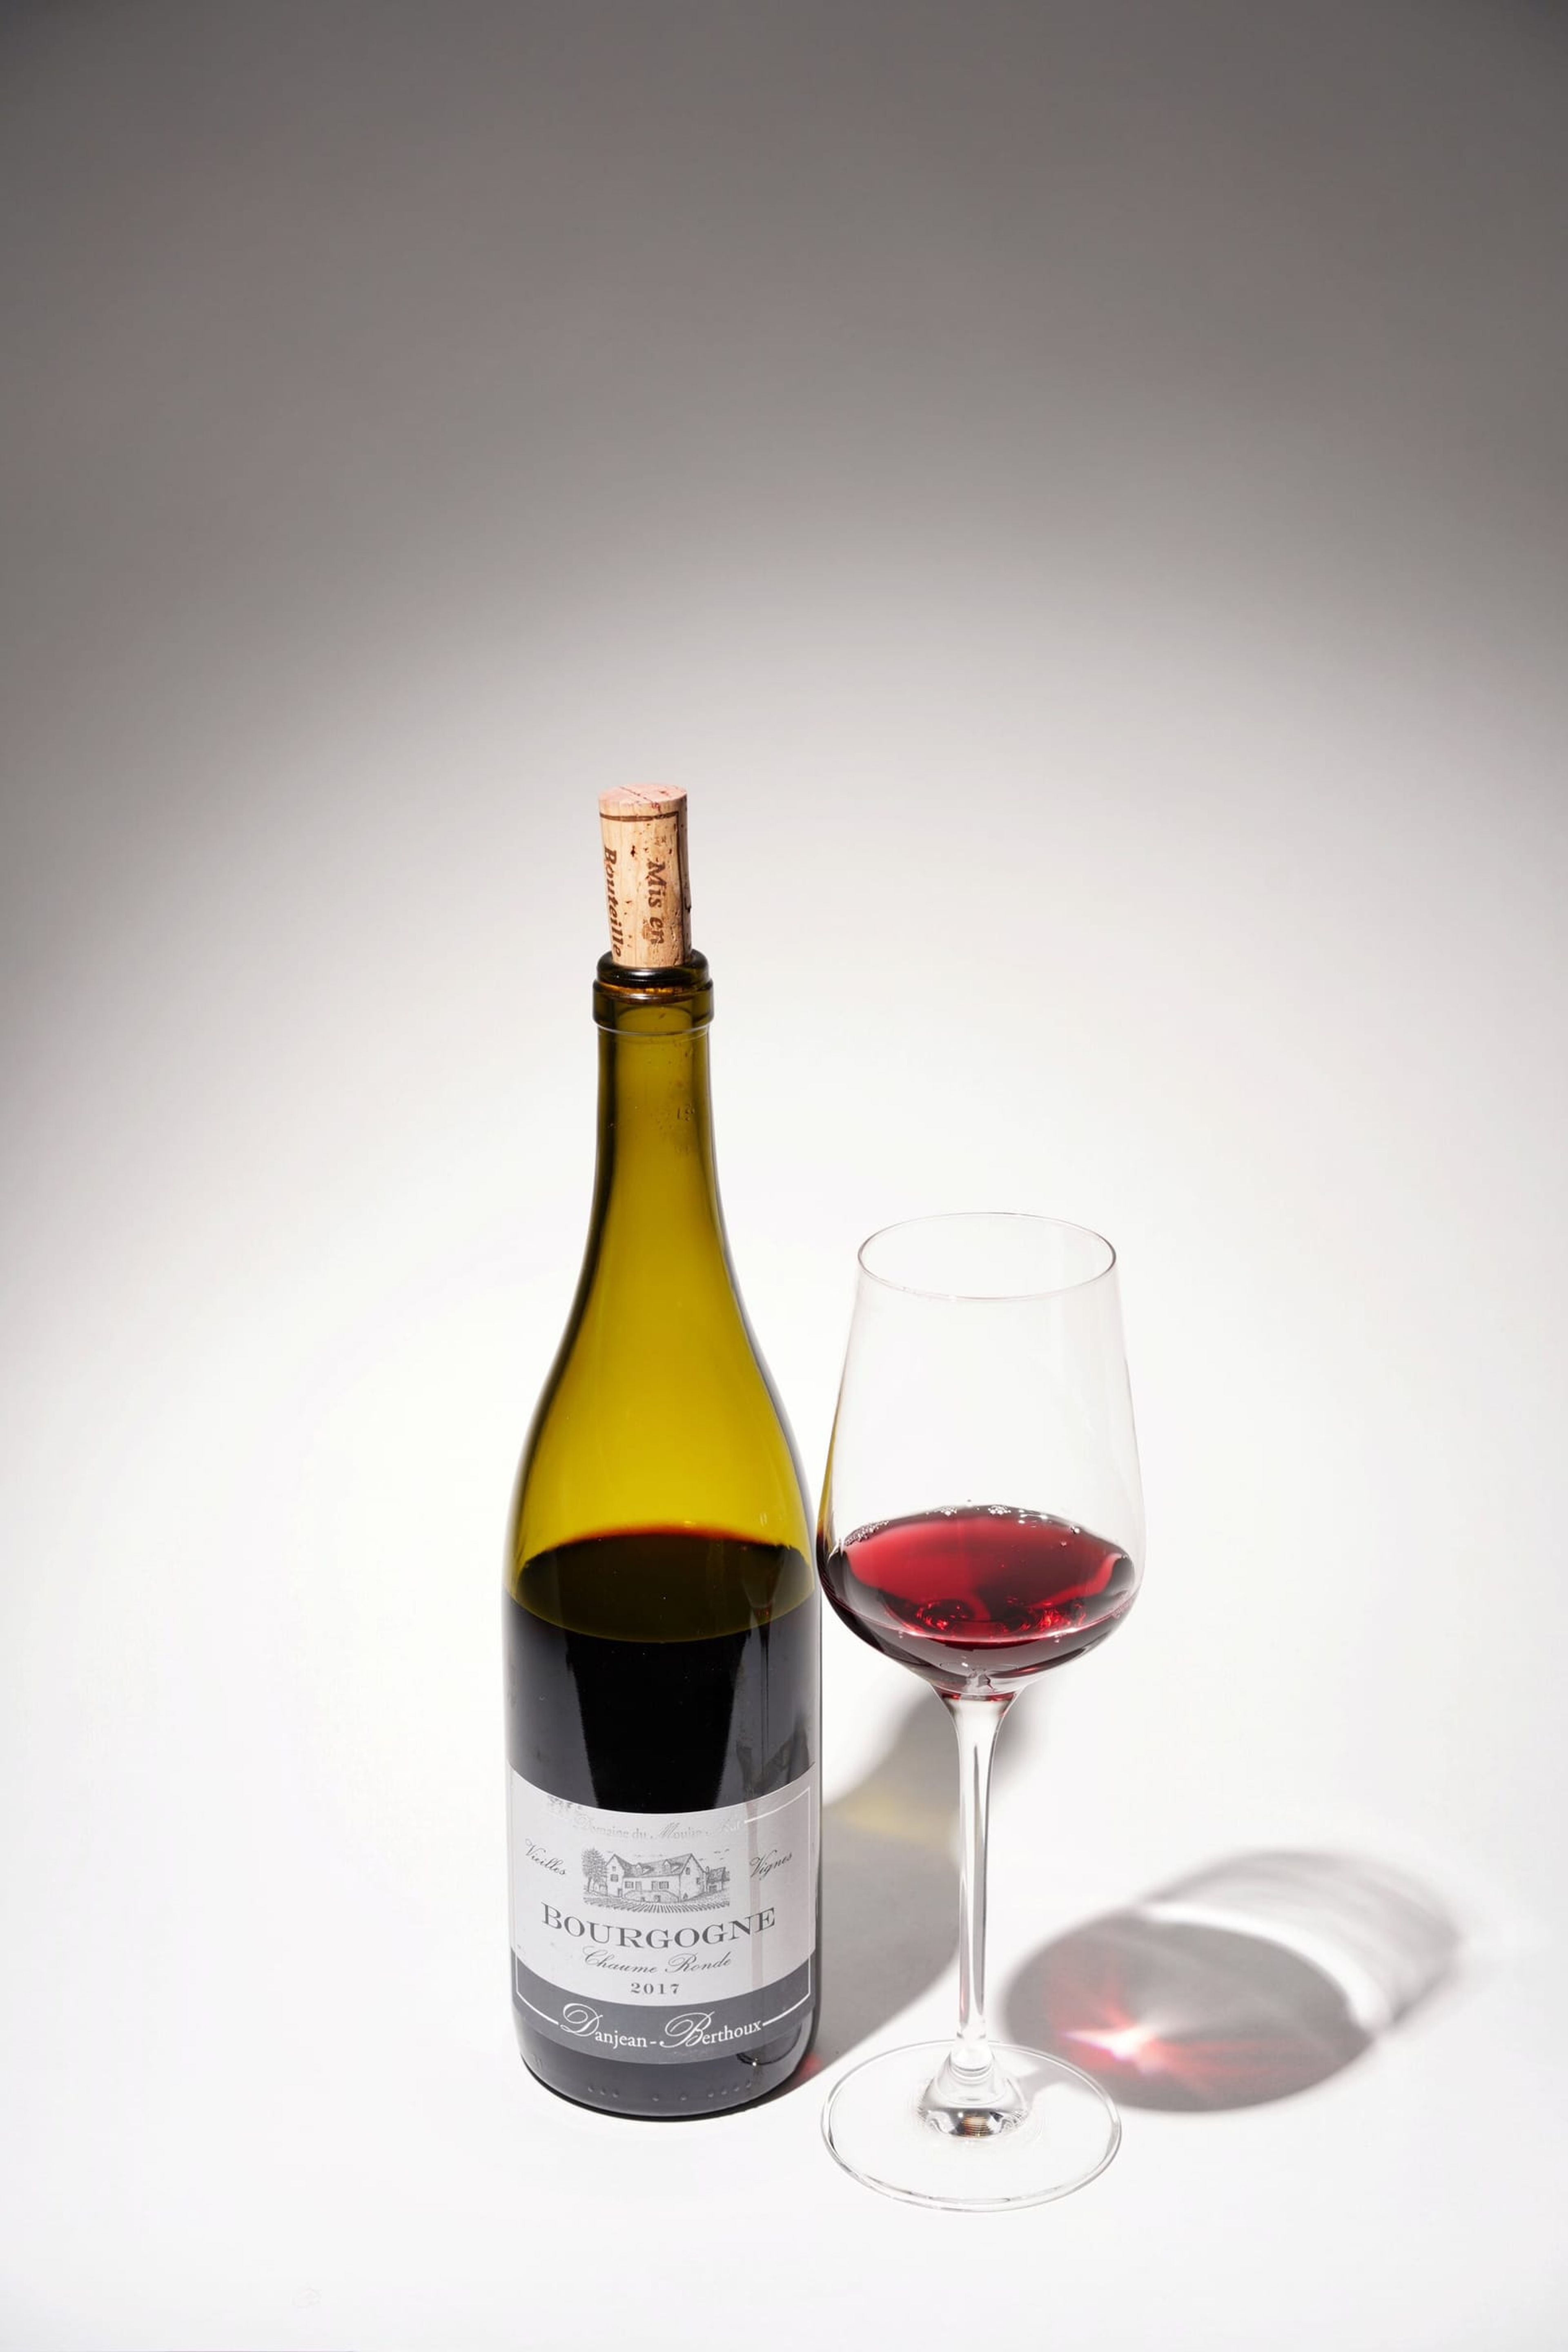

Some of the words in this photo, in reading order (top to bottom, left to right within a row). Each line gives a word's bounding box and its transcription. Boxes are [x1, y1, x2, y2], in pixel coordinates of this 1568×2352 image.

[646, 858, 668, 908] Mis
[604, 846, 624, 957] Bouteille
[648, 916, 665, 945] en
[631, 1828, 647, 1839] du
[525, 1838, 566, 1876] Vieilles
[749, 1849, 793, 1881] Vignes
[541, 1902, 775, 1949] BOURGOGNE
[582, 1945, 657, 1973] Chaume
[665, 1951, 731, 1973] Ronde
[630, 1982, 679, 1994] 2017
